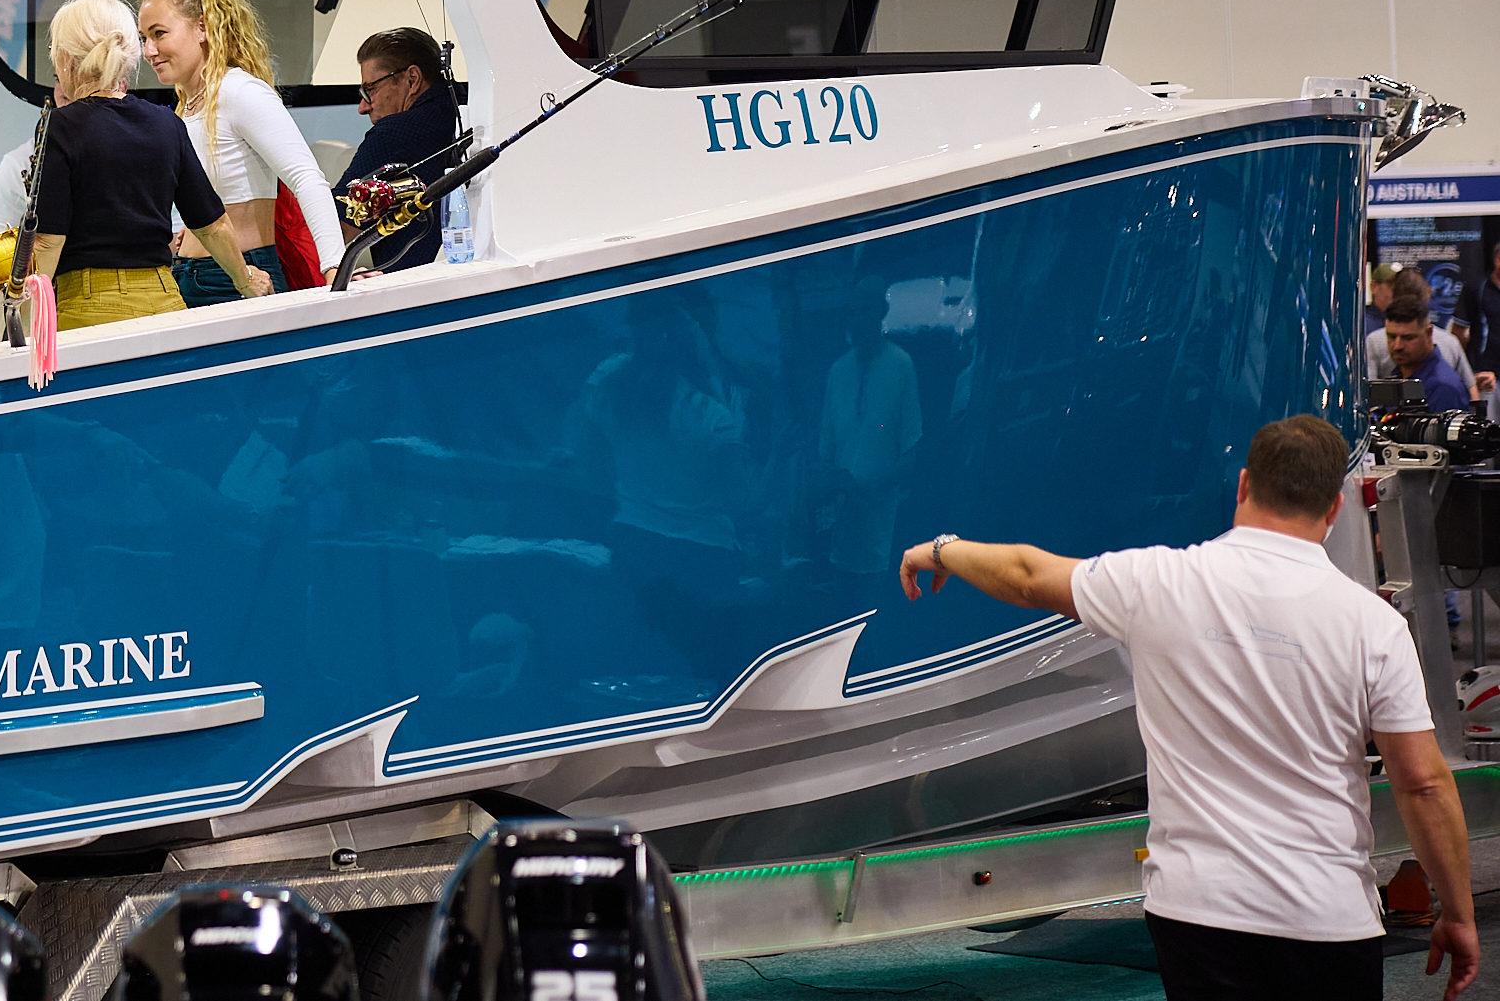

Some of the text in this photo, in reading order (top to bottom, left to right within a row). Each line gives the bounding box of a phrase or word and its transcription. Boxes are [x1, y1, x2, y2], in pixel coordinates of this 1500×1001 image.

[696, 84, 878, 153] HG120
[1375, 182, 1460, 202] AUSTRALIA
[530, 969, 618, 1001] 25
